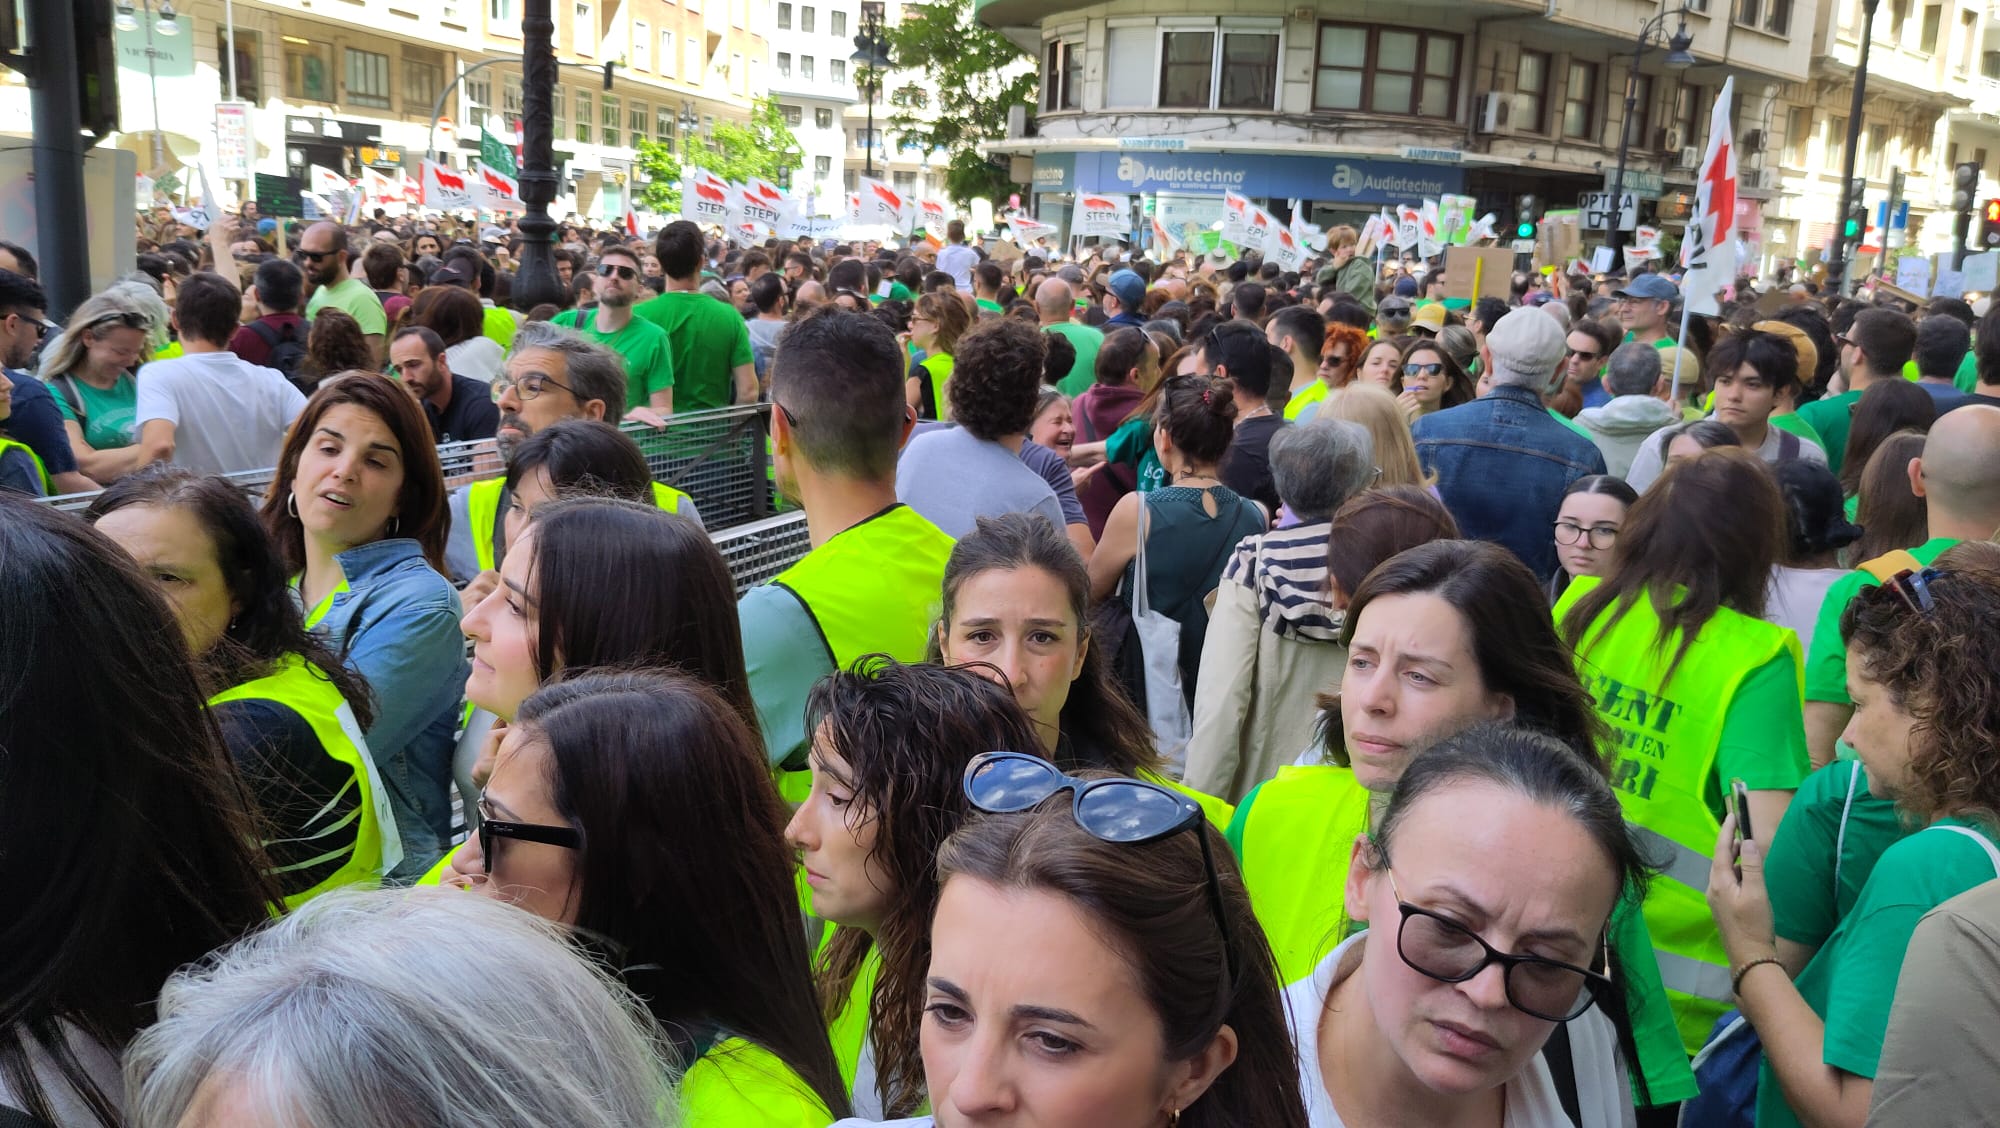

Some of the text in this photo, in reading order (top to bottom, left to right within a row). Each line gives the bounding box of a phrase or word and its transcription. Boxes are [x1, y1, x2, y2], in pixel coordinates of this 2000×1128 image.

[125, 47, 175, 61] VICTRIA
[1145, 165, 1244, 183] Audiotechno
[1363, 175, 1442, 193] Audiotechno
[696, 201, 731, 217] STEPV
[743, 205, 780, 222] STEPV
